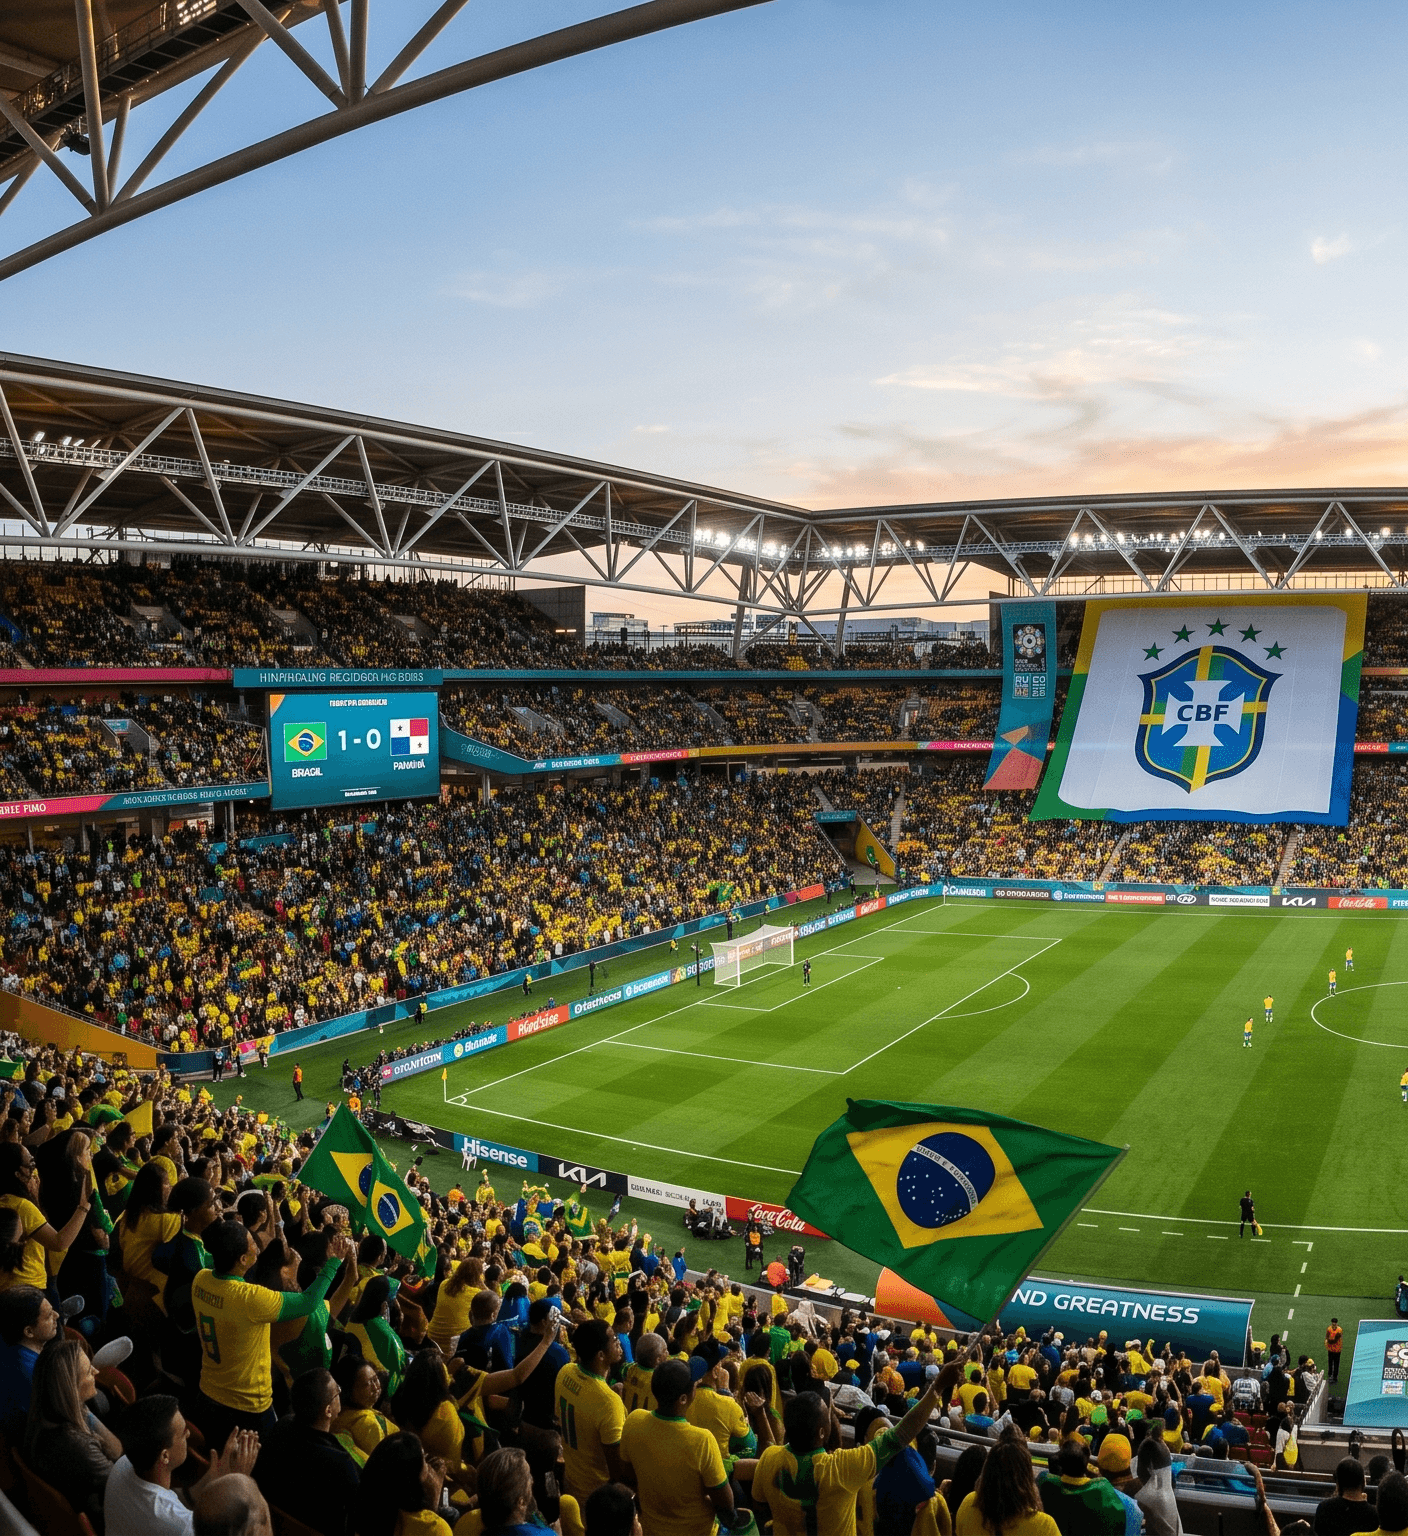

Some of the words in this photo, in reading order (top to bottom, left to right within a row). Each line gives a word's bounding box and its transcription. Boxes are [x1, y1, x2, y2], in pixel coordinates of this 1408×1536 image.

[1176, 704, 1230, 722] CBF
[463, 1137, 528, 1168] Hisense
[1053, 1293, 1200, 1325] GREATNESS
[199, 1311, 221, 1365] 9
